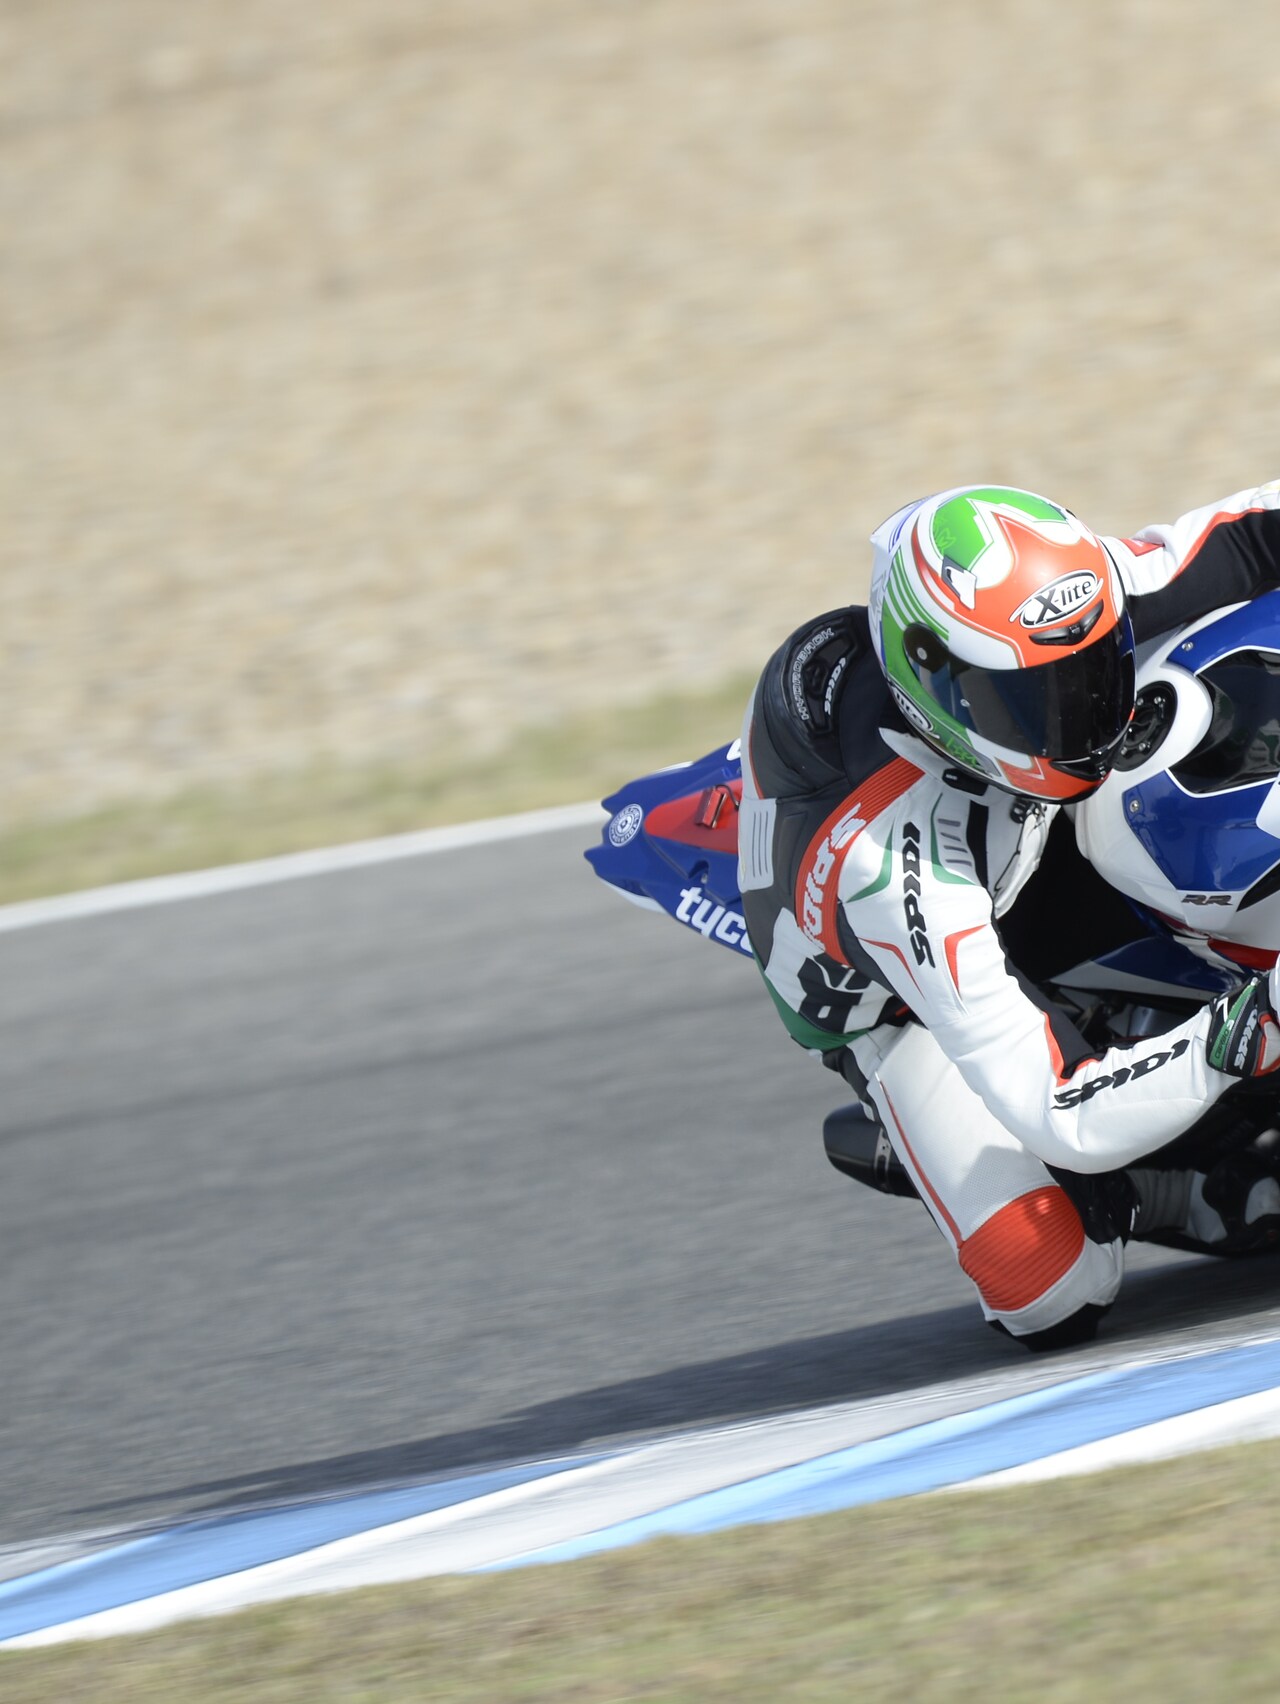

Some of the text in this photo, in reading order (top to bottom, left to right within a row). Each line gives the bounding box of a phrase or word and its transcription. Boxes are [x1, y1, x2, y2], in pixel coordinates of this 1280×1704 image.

[1033, 578, 1094, 626] X-lite
[902, 820, 936, 969] SPIDI
[1233, 1009, 1258, 1070] SPID
[1051, 1039, 1190, 1110] SPIDI
